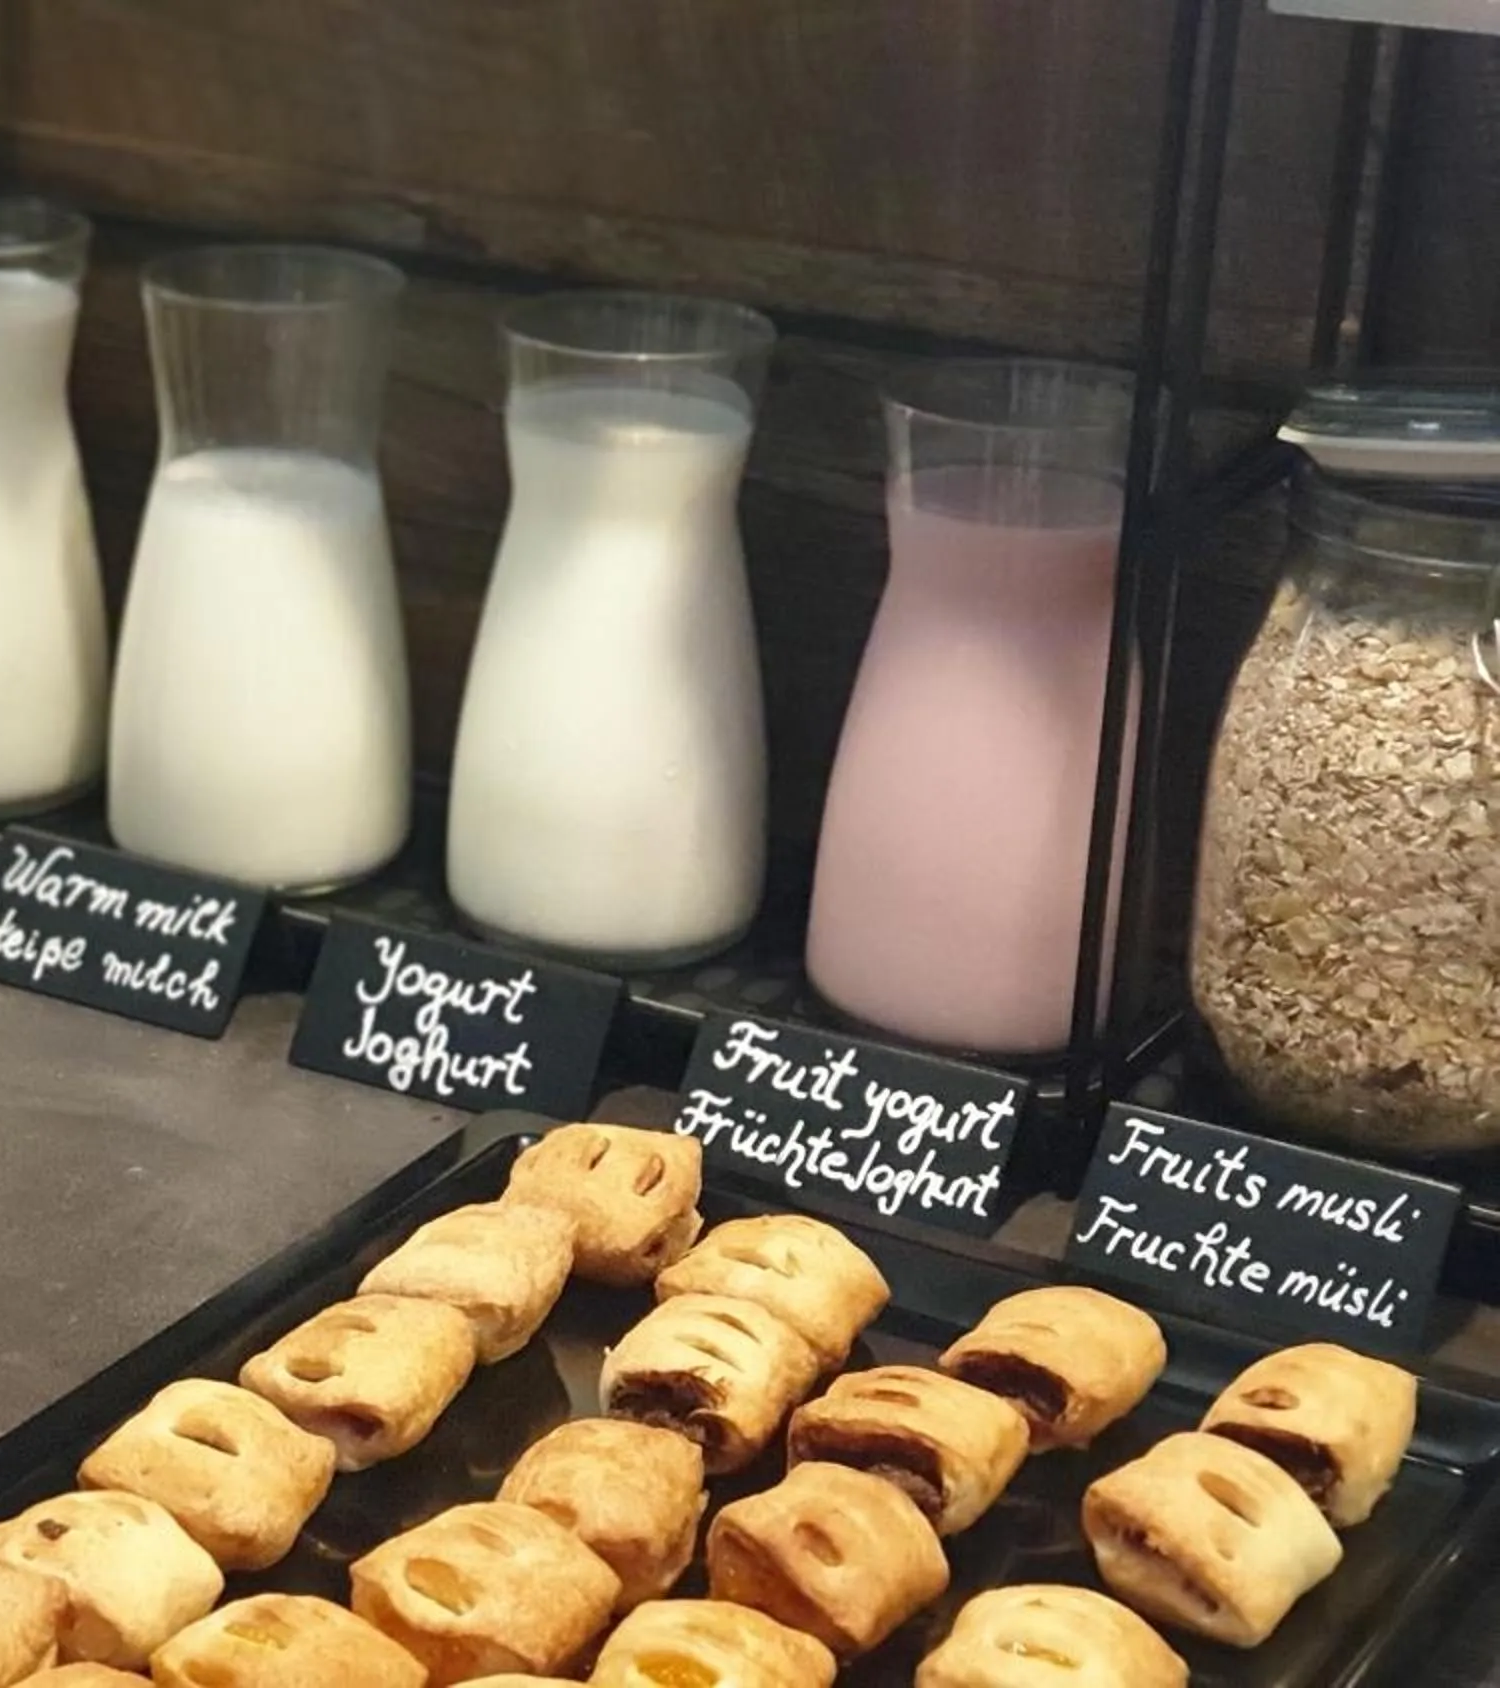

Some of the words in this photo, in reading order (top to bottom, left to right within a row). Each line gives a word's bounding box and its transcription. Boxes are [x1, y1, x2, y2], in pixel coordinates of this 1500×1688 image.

[2, 843, 129, 920] Warm
[135, 894, 237, 945] milk
[102, 951, 220, 1011] milch
[355, 936, 537, 1034] Yogurt
[343, 1004, 534, 1096] Joghurt
[712, 1020, 859, 1111] Fruit
[840, 1080, 1015, 1155] yogurt
[1108, 1117, 1267, 1209] Fruits
[1276, 1183, 1421, 1243] musli
[1076, 1195, 1271, 1294] Fruchte
[1277, 1262, 1409, 1328] müsli
